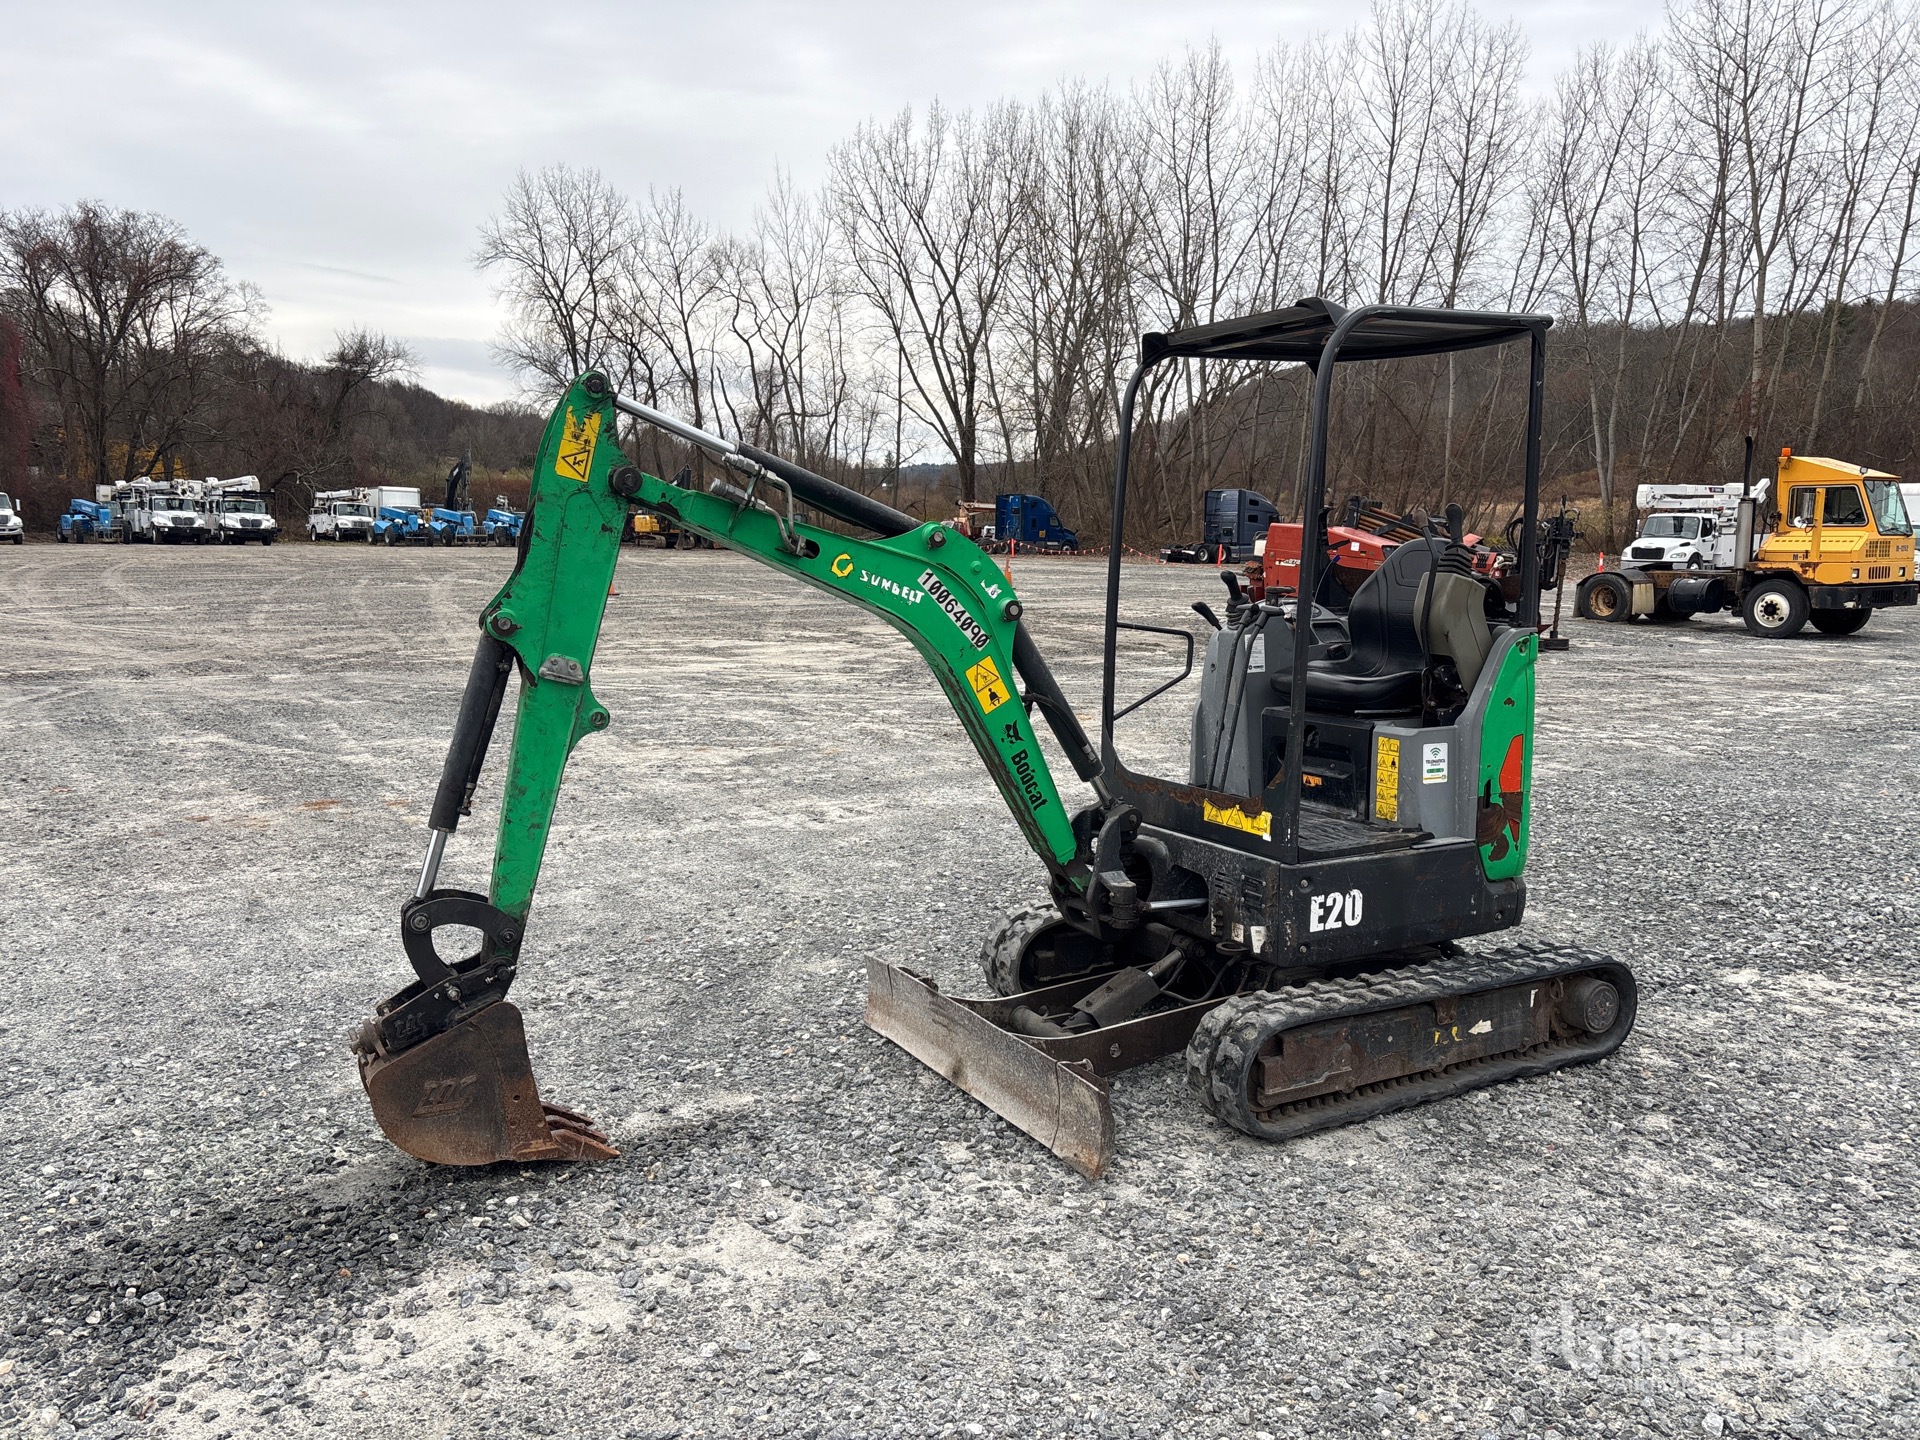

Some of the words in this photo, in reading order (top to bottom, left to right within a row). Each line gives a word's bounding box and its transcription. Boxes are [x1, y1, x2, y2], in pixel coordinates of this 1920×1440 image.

[859, 569, 925, 604] SUNBELT
[921, 571, 990, 648] 10064090
[1010, 748, 1048, 812] Bobcat
[1309, 888, 1363, 933] E20
